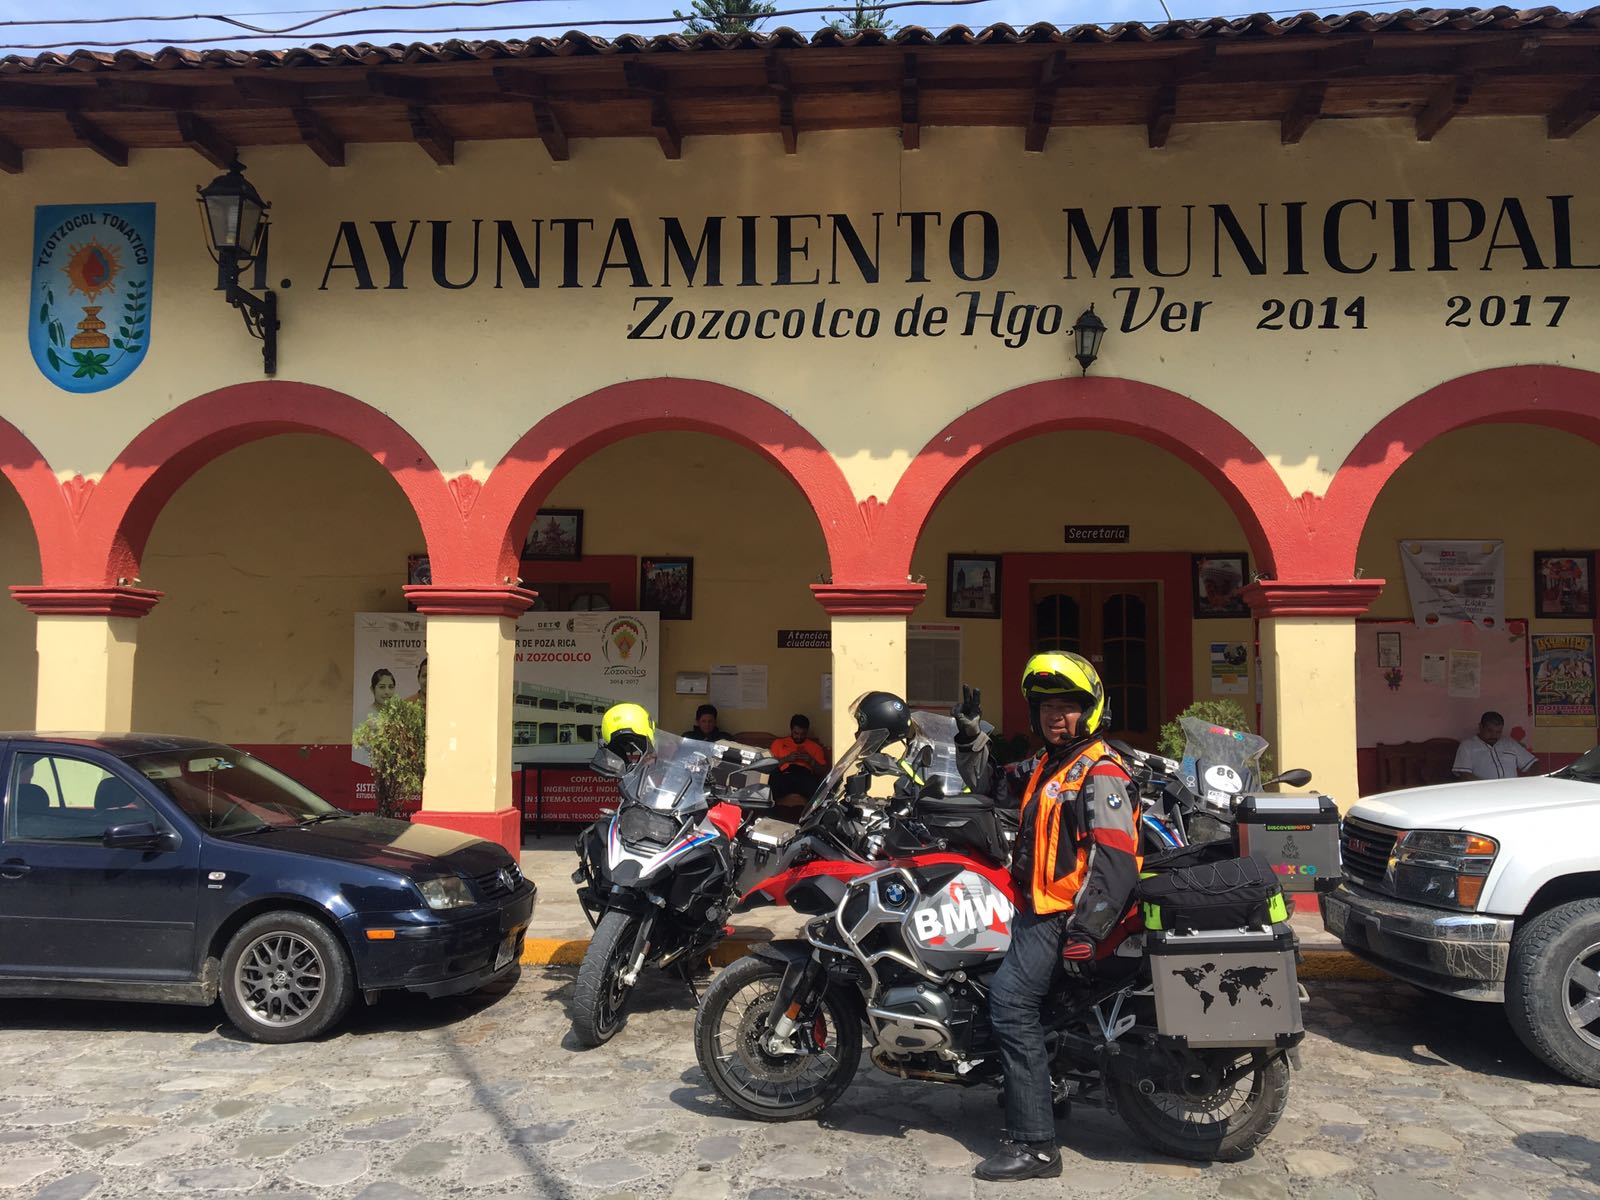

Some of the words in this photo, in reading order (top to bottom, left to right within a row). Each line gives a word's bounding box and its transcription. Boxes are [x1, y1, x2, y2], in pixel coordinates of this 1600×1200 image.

[37, 212, 97, 268] TZOTZOCOL
[102, 212, 149, 265] TONATICO
[318, 210, 1000, 291] AYUNTAMIENTO
[1063, 195, 1600, 280] MUNICIPAL
[627, 296, 881, 340] Zozocolco
[894, 293, 949, 337] de
[1112, 286, 1213, 334] Ver
[1256, 296, 1369, 330] 2014
[1445, 295, 1571, 328] 2017
[1068, 527, 1126, 539] Secretaria
[787, 631, 829, 639] Atención
[379, 639, 422, 648] INSTITUTO
[522, 639, 533, 648] DE
[534, 639, 556, 648] POZA
[557, 639, 577, 648] RICA
[527, 652, 592, 663] ZOZOCOLCO
[604, 665, 647, 677] Zozocolco
[1216, 767, 1235, 779] 86
[356, 783, 376, 792] SISTE
[543, 784, 593, 793] INGENIERÍAS
[914, 893, 1014, 941] BMW
